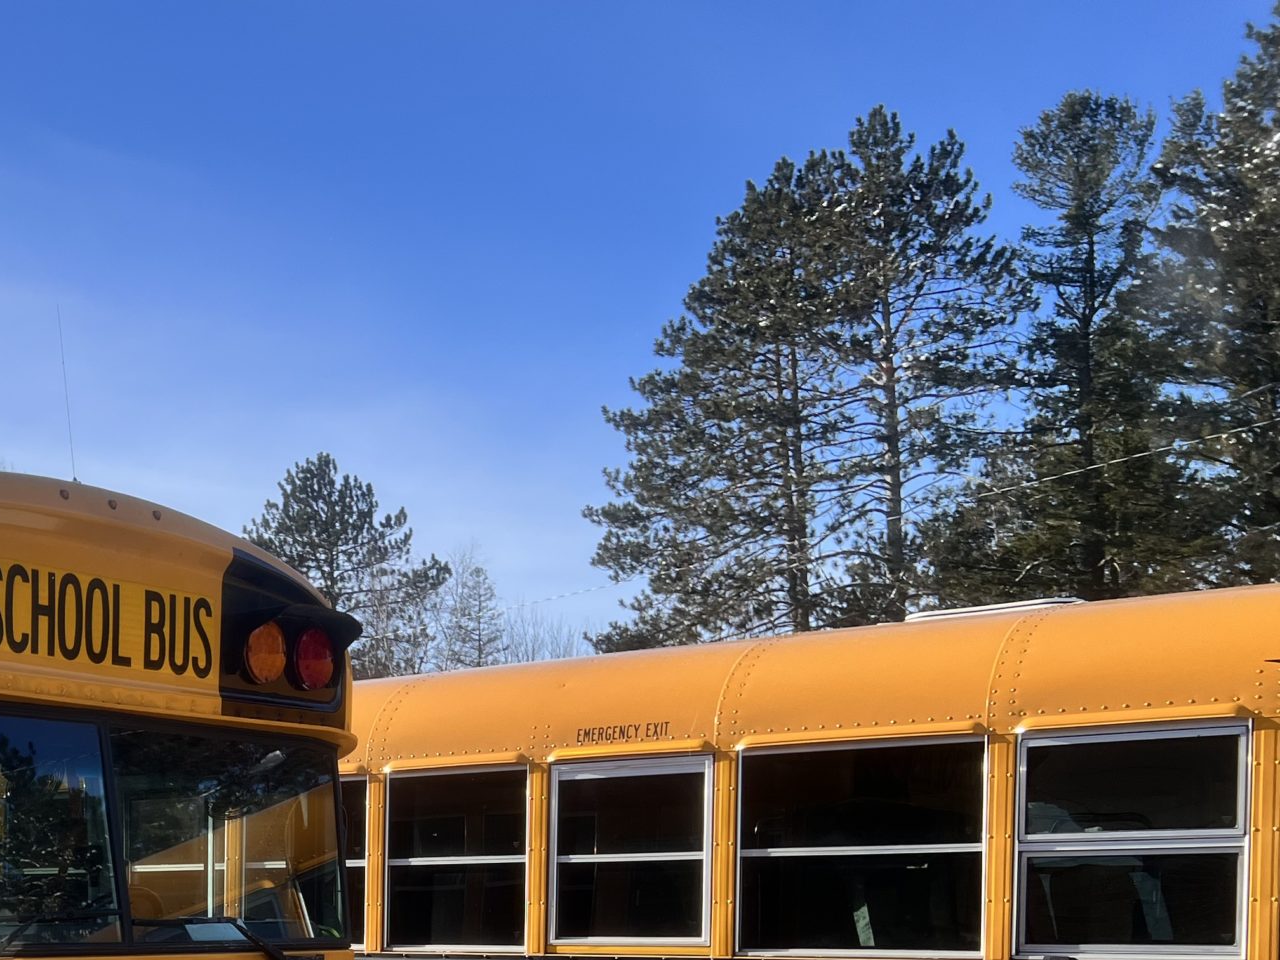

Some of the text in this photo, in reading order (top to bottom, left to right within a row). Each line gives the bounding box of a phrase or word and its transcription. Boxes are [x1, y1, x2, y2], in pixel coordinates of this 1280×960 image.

[143, 589, 213, 679] BUS
[576, 721, 670, 743] EMERGENCY EXIT
